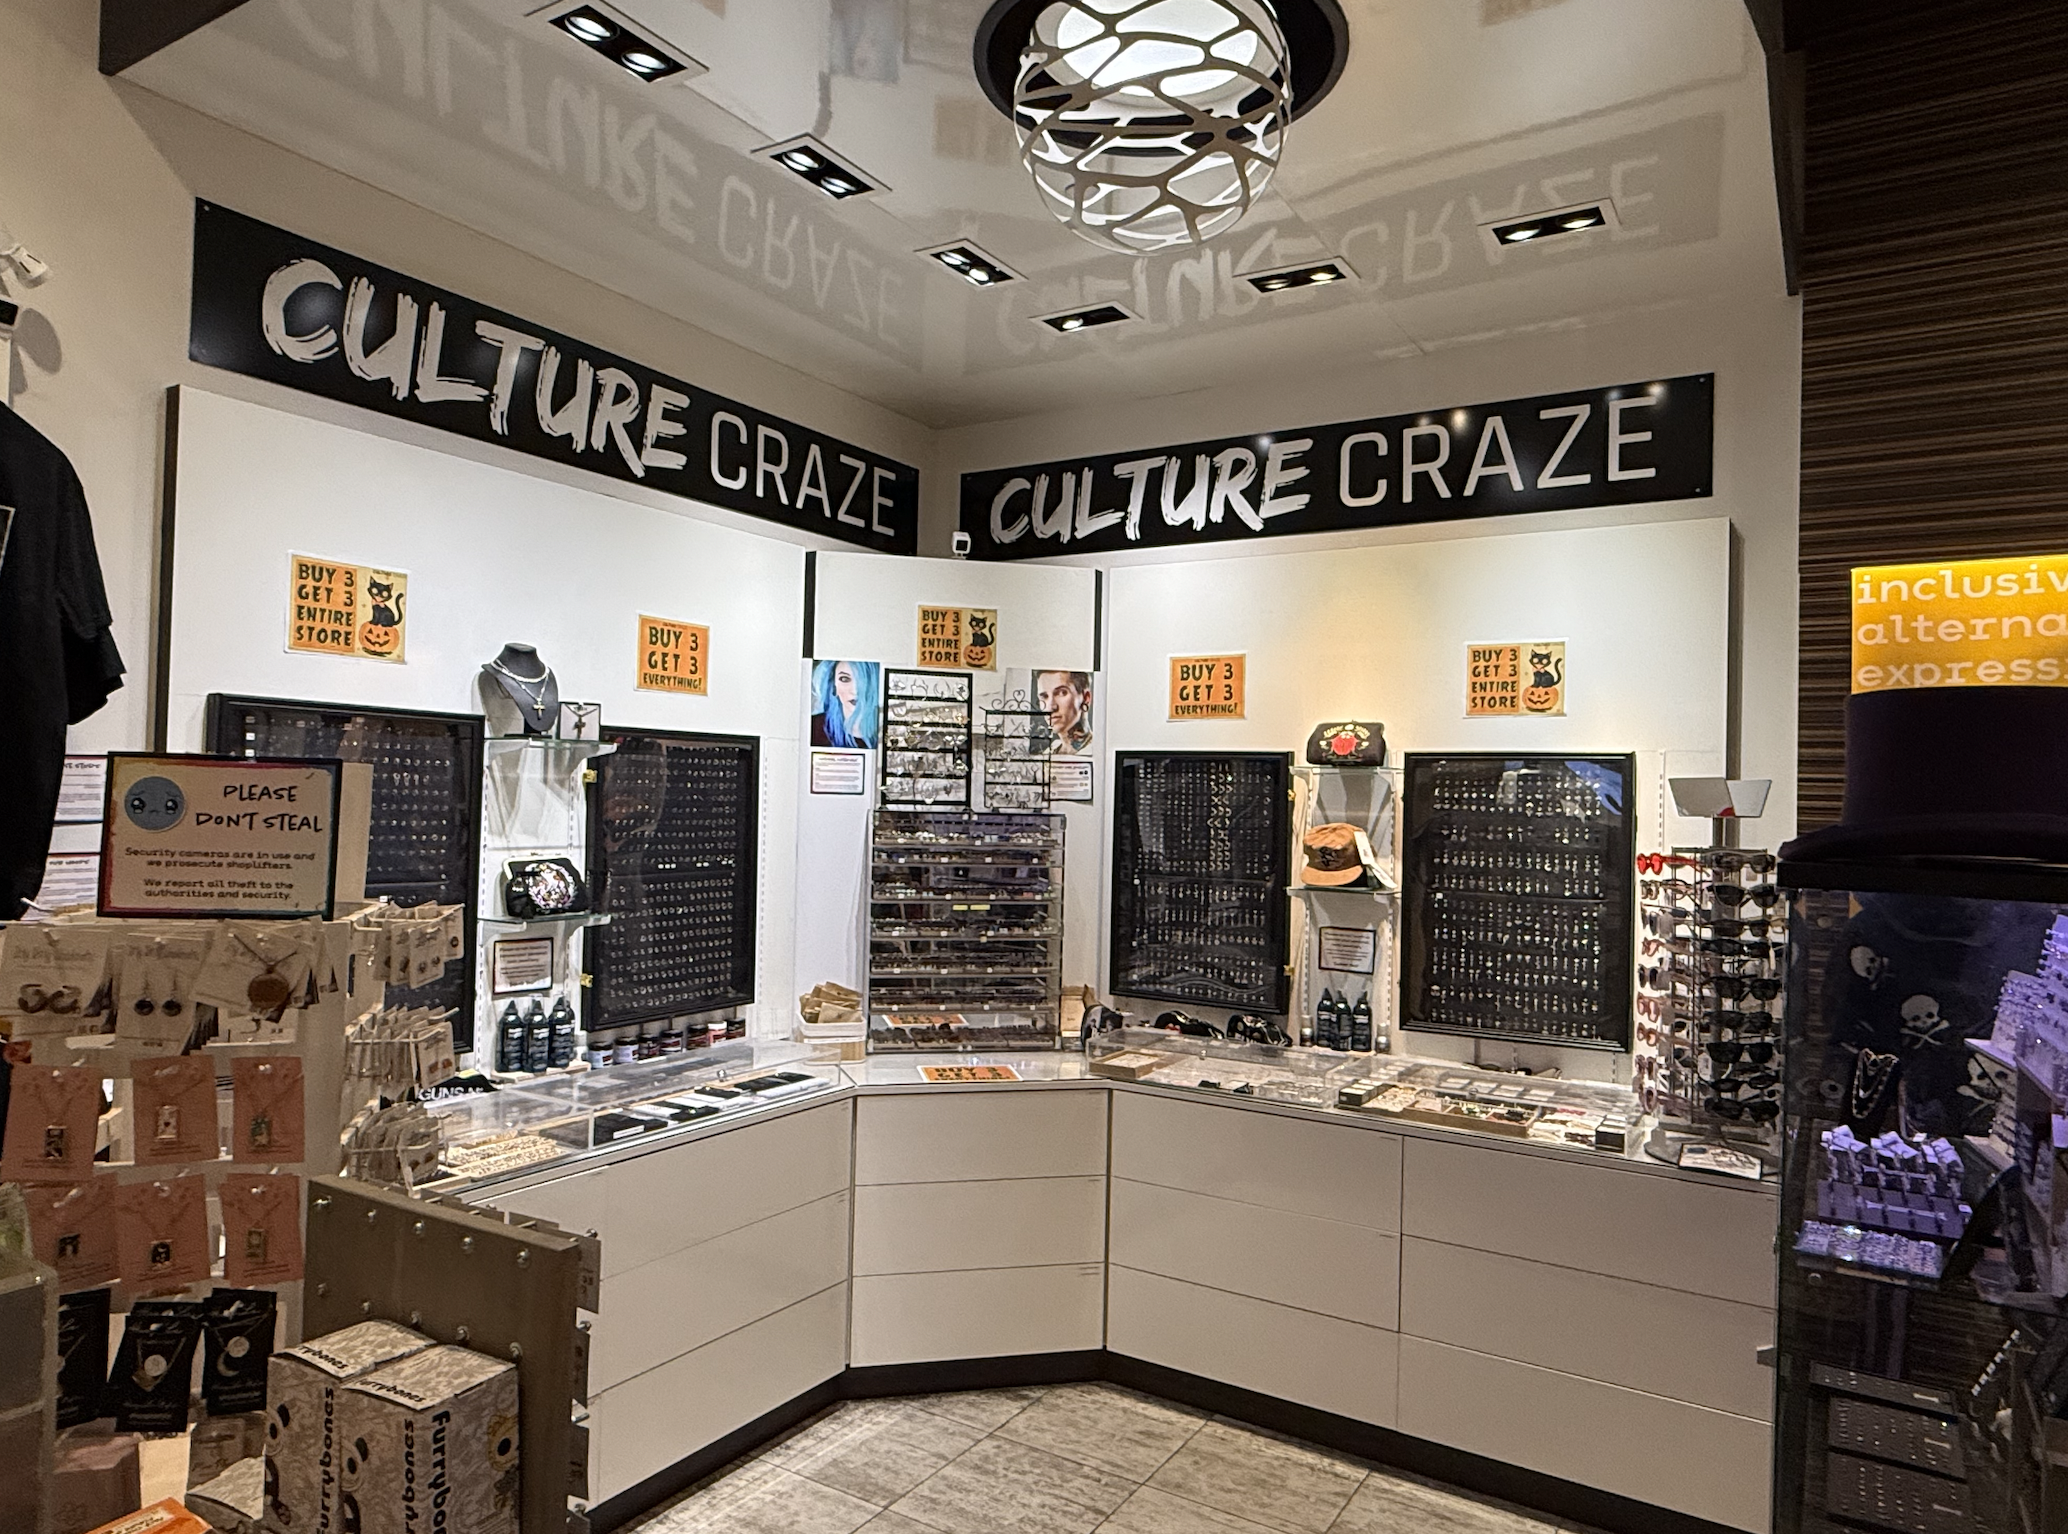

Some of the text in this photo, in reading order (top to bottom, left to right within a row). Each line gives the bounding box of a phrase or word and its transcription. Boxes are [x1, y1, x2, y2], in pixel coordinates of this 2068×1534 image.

[262, 258, 897, 537] CULTURE CRAZE
[990, 396, 1657, 543] CULTURE CRAZE
[299, 564, 336, 584] BUY
[344, 571, 354, 587] 3
[1857, 564, 2068, 604] inclusiv
[298, 584, 354, 607] GET 3
[297, 605, 354, 627] ENTIRE
[922, 610, 960, 623] BUY 3
[296, 625, 352, 646] STORE
[922, 623, 960, 636] GET 3
[1857, 613, 2068, 646] alterna
[649, 626, 699, 652] BUY 3
[921, 638, 959, 650] ENTIRE
[648, 651, 698, 675] GET 3
[921, 651, 959, 663] STORE
[1472, 649, 1518, 663] BUY 3
[1180, 663, 1233, 681] BUY 3
[1472, 664, 1518, 678] GET 3
[1857, 657, 2068, 688] express
[643, 672, 702, 690] EVERYTHING!
[1471, 681, 1517, 693] ENTIRE
[1179, 684, 1233, 702] GET 3
[1471, 696, 1517, 708] STORE
[1174, 702, 1238, 715] EVERYTHING!
[223, 784, 298, 802] PLEASE
[195, 812, 323, 833] DON'T STEAL
[125, 846, 315, 861] Security cameras are in use and
[147, 859, 162, 867] we
[165, 859, 223, 869] prosecute
[144, 878, 294, 890] We report all theft to the
[145, 888, 215, 899] authorities
[217, 890, 240, 899] and
